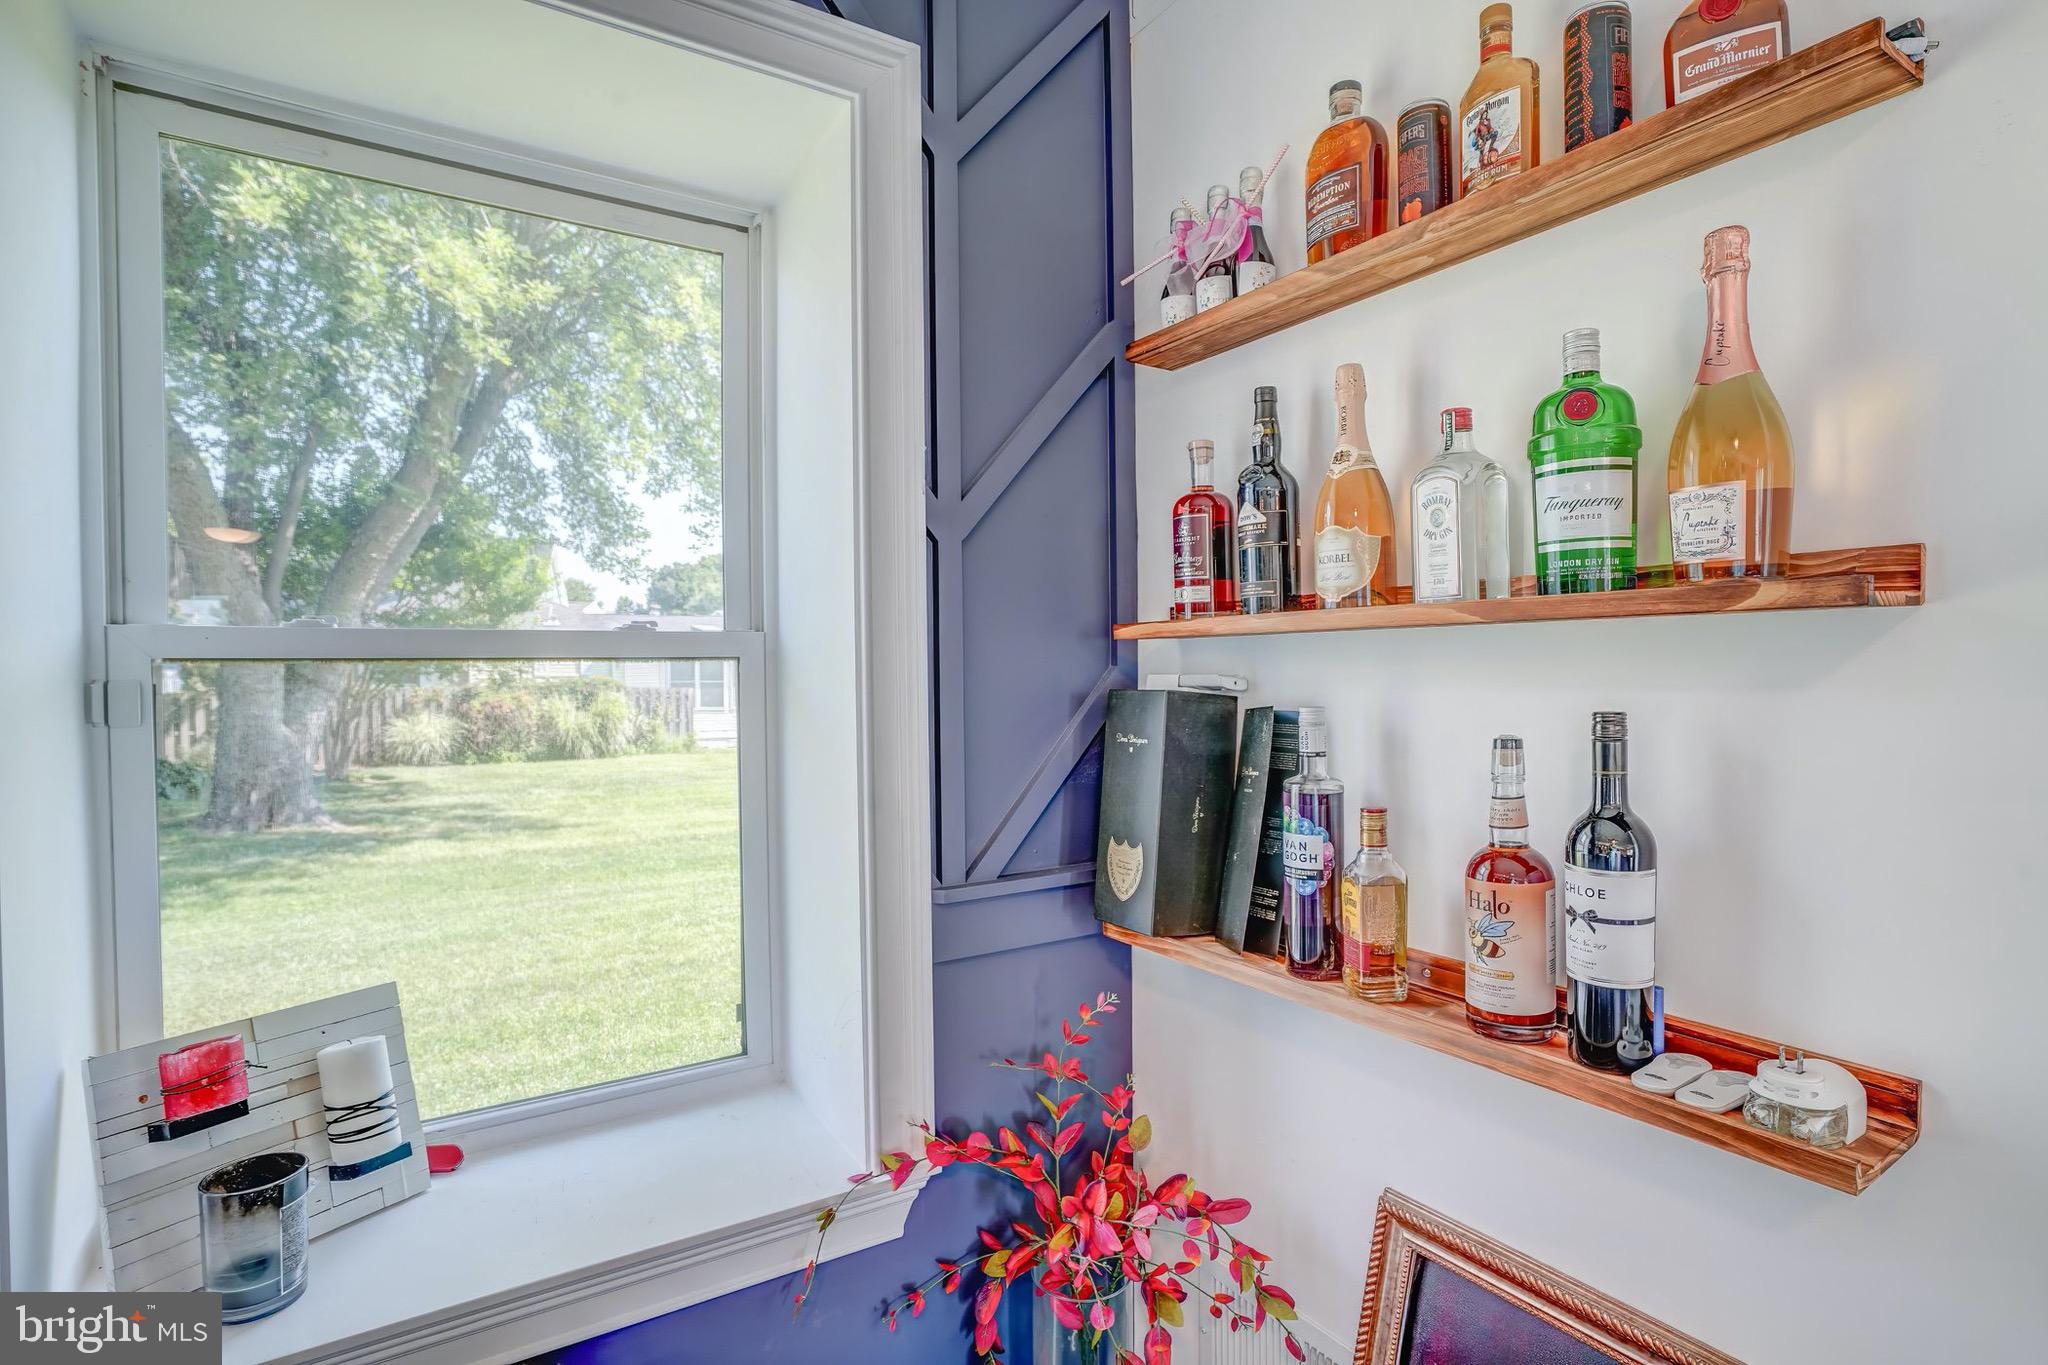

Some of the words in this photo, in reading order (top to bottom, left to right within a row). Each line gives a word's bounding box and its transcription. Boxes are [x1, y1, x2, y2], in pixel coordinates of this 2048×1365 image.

[1685, 57, 1720, 78] Grand
[1720, 44, 1772, 66] Marnier
[1421, 495, 1453, 511] BOMBAY
[1544, 496, 1624, 514] Tanqueray
[1560, 513, 1602, 522] IMPORTED
[1681, 512, 1719, 537] Cupcake
[1423, 529, 1439, 541] DRY
[1439, 527, 1453, 540] GIN
[1318, 553, 1354, 566] KORBEL
[1549, 559, 1581, 569] LONDON
[1606, 557, 1620, 565] GIN
[1285, 839, 1307, 851] VAN
[1285, 851, 1318, 863] GOGH
[1565, 880, 1606, 899] CHLOE
[1468, 889, 1511, 920] Halo
